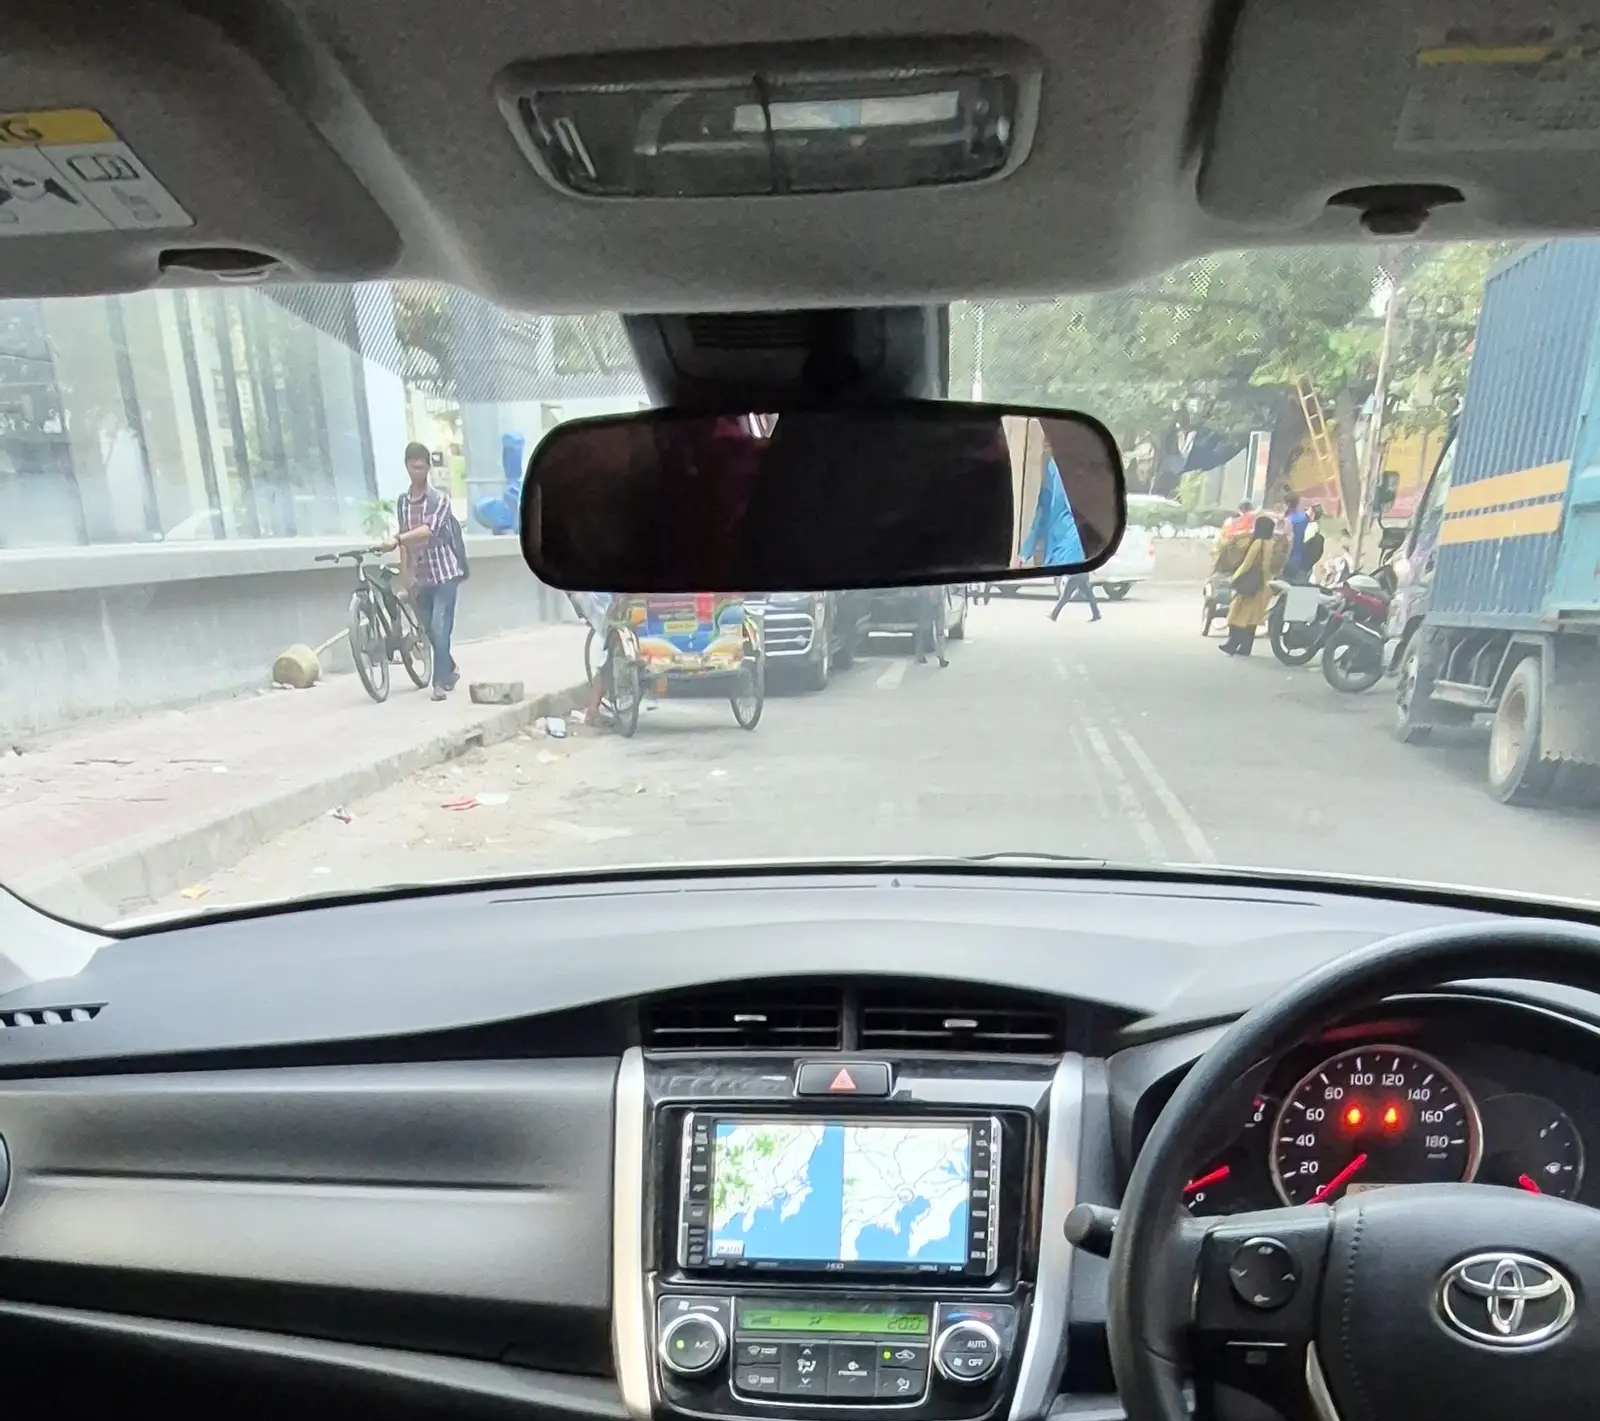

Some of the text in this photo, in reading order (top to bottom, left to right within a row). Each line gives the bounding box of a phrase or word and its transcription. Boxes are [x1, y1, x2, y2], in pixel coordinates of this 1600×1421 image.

[1350, 1073, 1373, 1086] 100
[1382, 1073, 1404, 1086] 120
[1324, 1087, 1343, 1100] 80
[1408, 1088, 1430, 1101] 140
[1306, 1108, 1325, 1121] 60
[1421, 1110, 1443, 1123] 160
[1296, 1134, 1315, 1147] 40
[1425, 1135, 1449, 1148] 180
[1300, 1161, 1319, 1174] 20
[967, 1340, 987, 1348] AUTO
[968, 1358, 983, 1366] OFF
